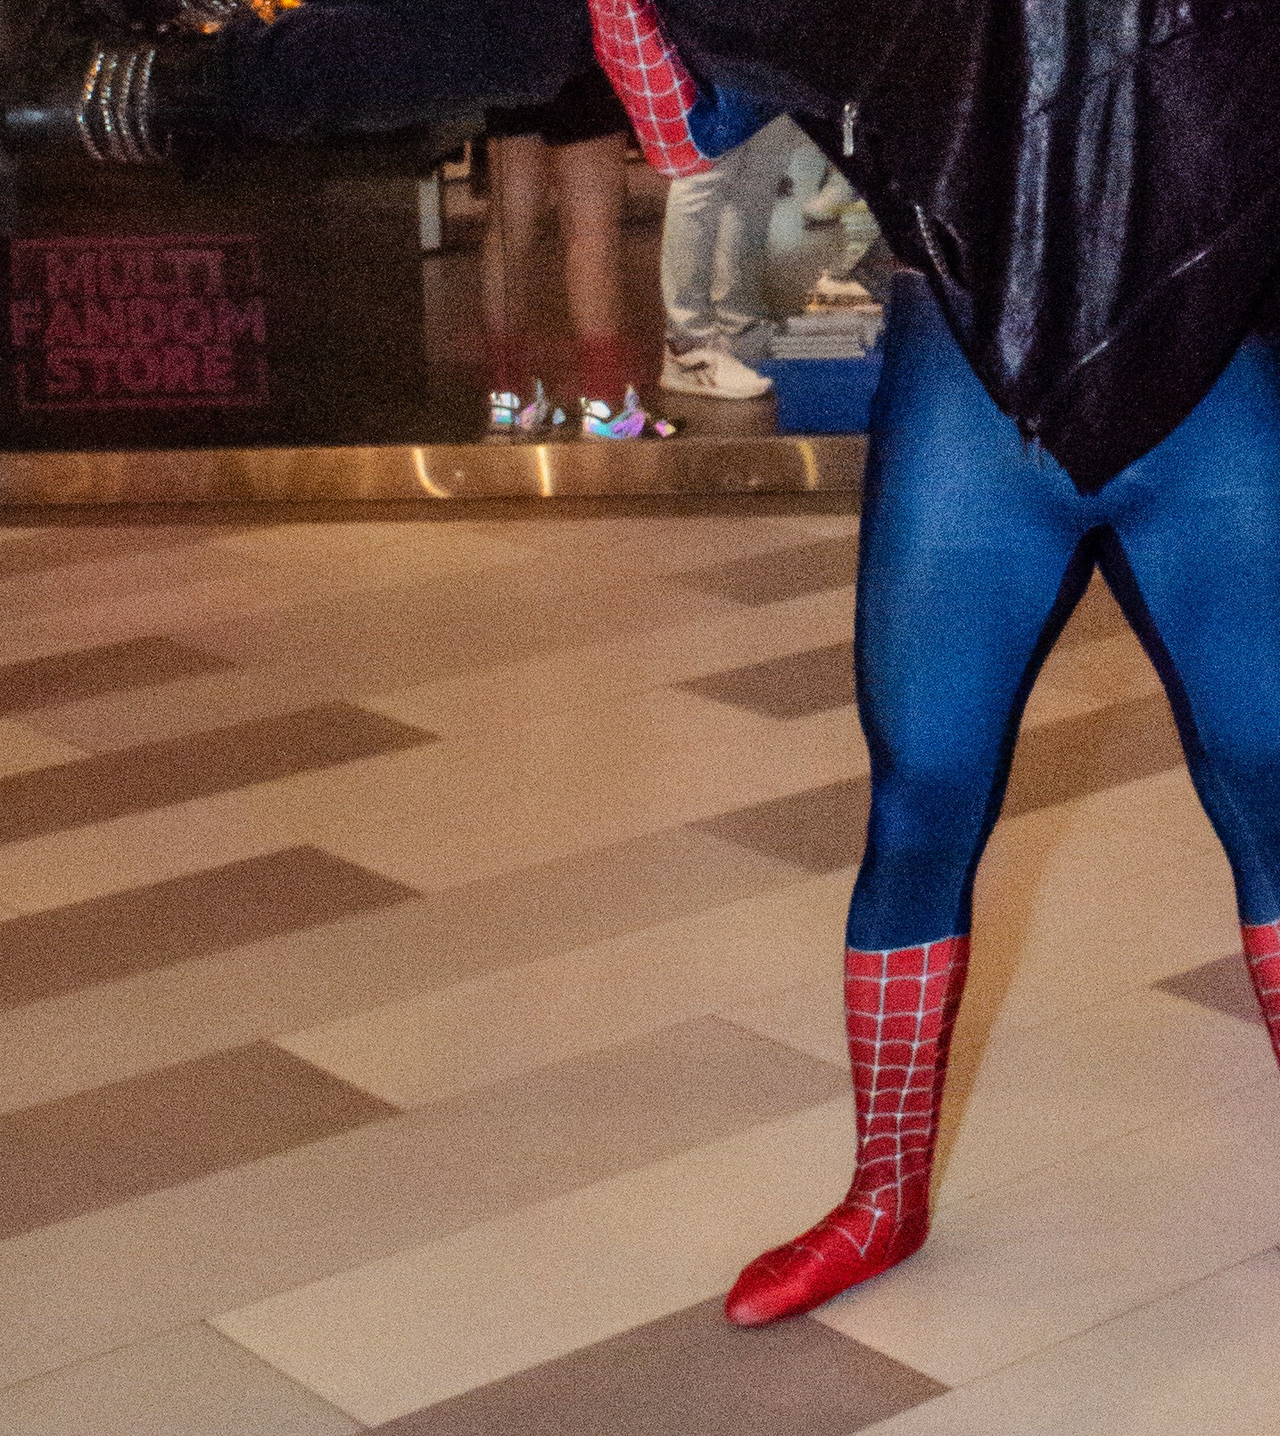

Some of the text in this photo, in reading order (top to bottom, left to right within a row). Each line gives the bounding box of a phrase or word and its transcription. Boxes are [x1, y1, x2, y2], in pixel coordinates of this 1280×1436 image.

[45, 250, 225, 298] MULTI
[9, 297, 267, 347] FANDOM
[46, 346, 236, 393] STORE
